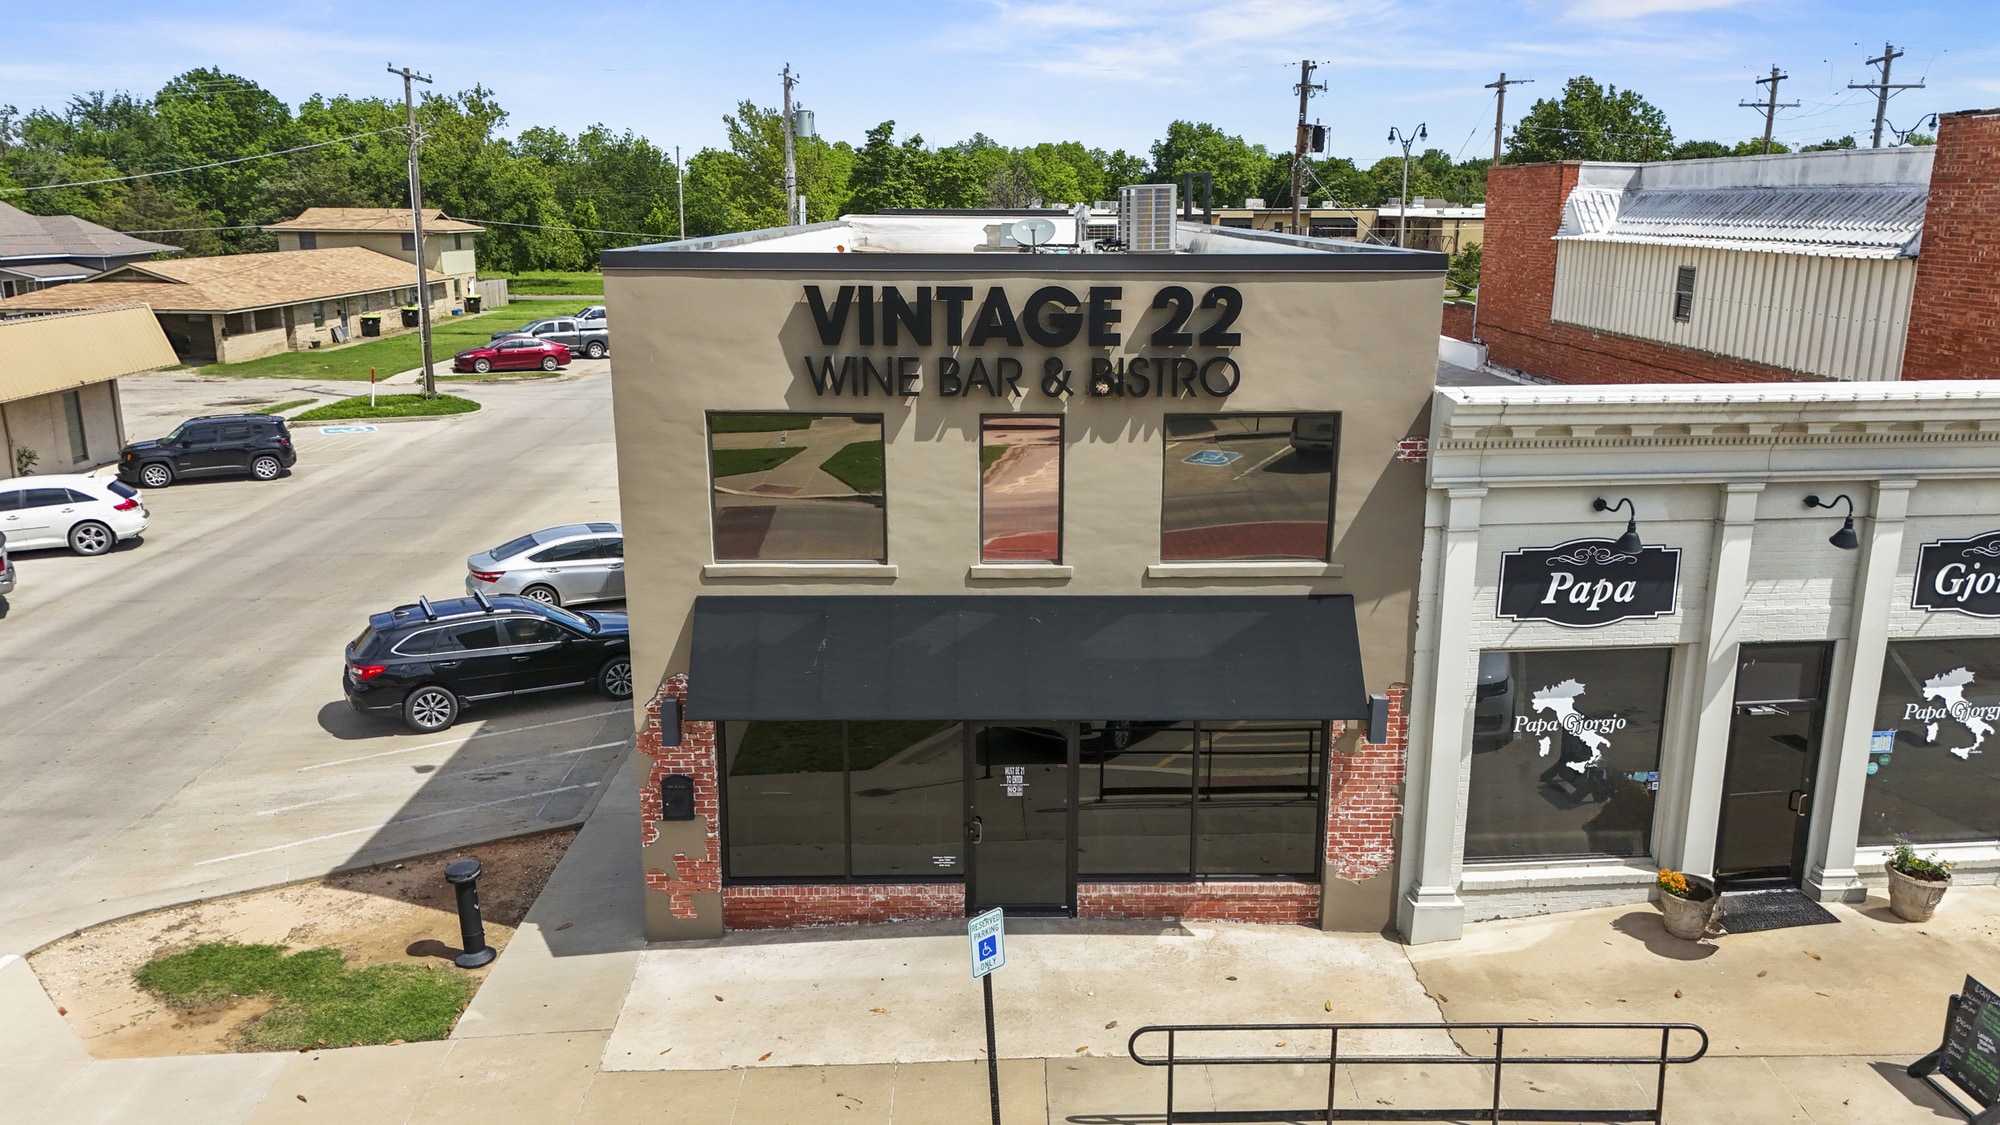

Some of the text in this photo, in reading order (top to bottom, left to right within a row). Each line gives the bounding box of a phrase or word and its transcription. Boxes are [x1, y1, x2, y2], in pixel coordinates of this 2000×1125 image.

[803, 285, 1243, 347] VINTAGE 22
[804, 356, 1241, 398] WINE BAR & BISTRO
[1541, 572, 1637, 611] Papa
[1903, 703, 1947, 723] Papa
[1513, 713, 1627, 736] Papa Gjorgjo
[971, 913, 1001, 932] RESERVED
[974, 923, 1000, 941] PARKING
[980, 957, 997, 971] ONLY
